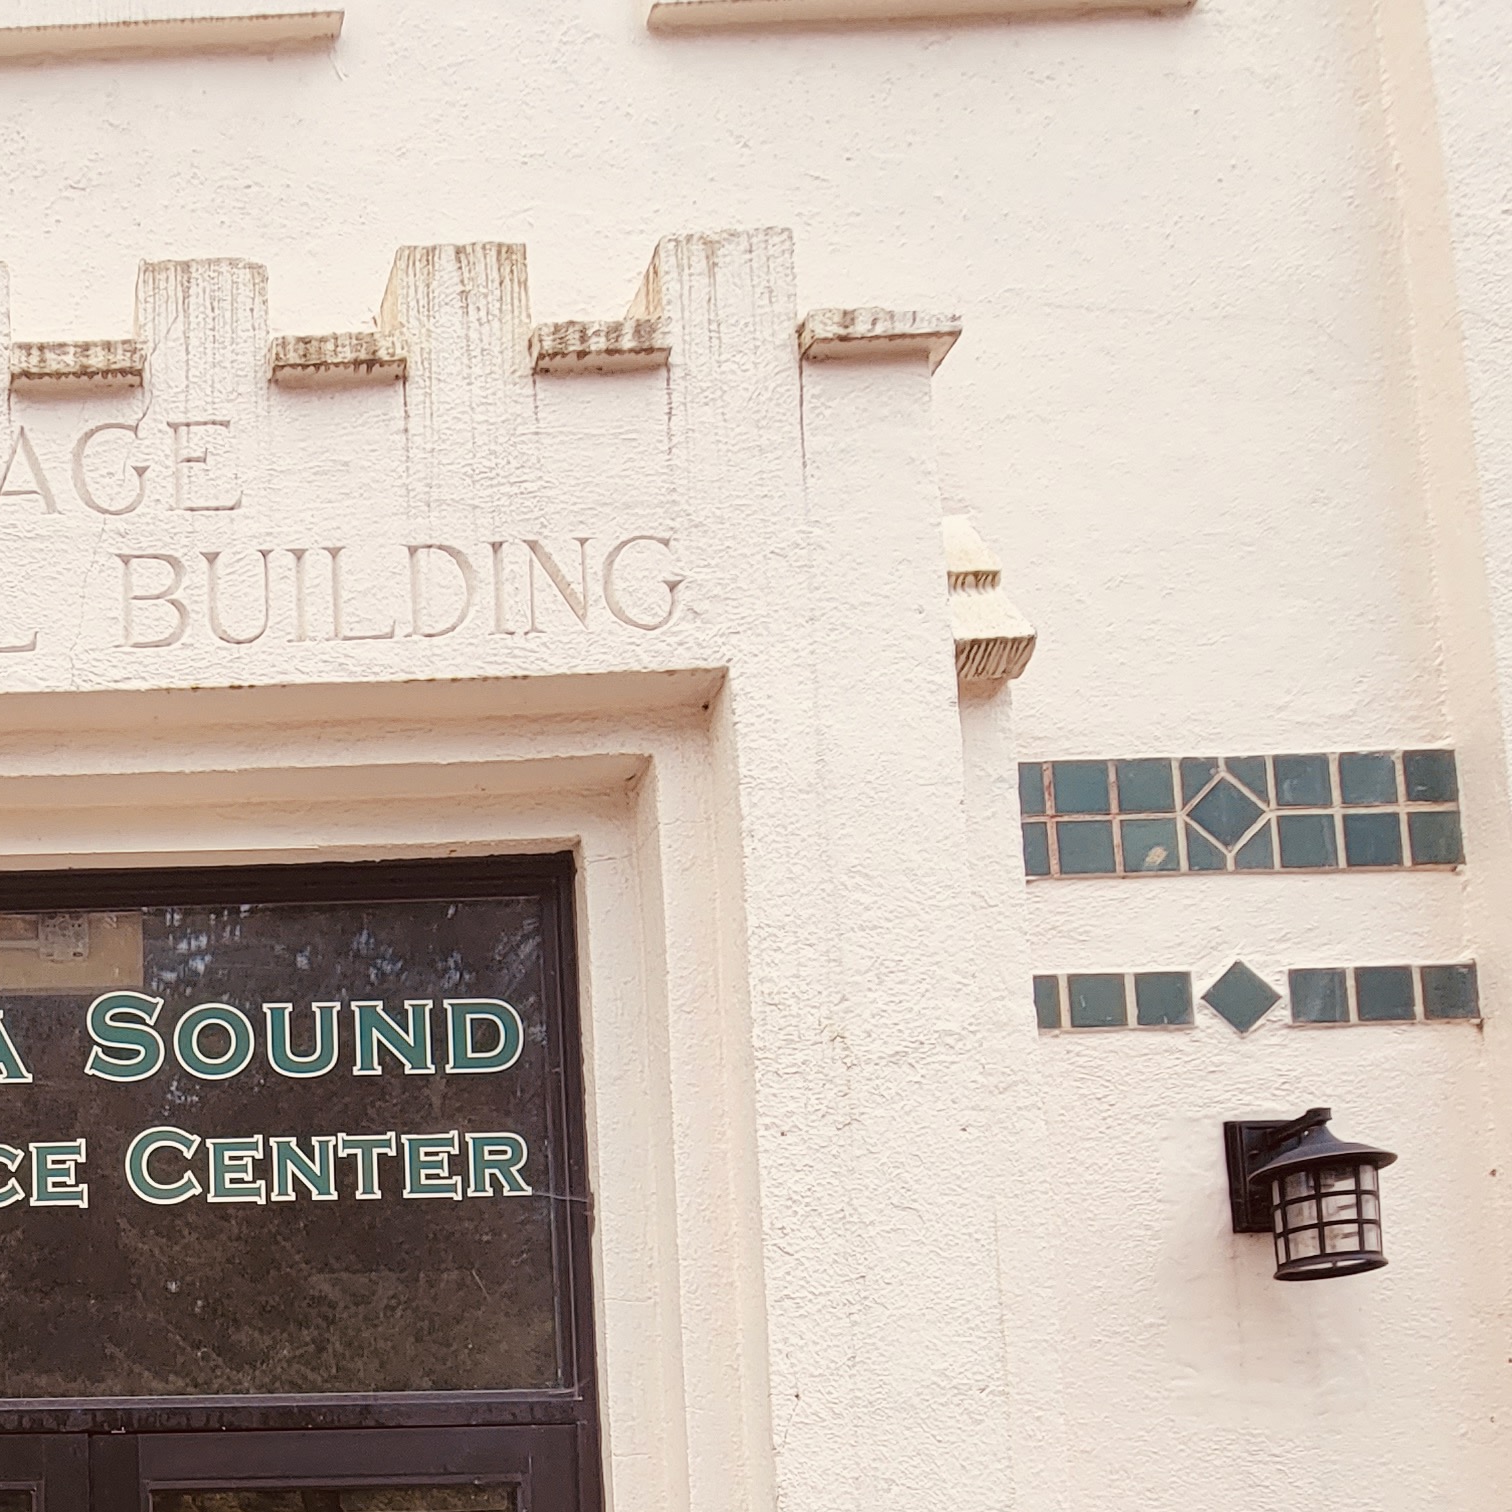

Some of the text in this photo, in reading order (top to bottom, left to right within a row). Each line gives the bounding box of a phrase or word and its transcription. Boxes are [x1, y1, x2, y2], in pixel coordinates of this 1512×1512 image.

[115, 535, 686, 650] BUILDING
[84, 991, 524, 1082] SOUND
[124, 1126, 533, 1205] CENTER
